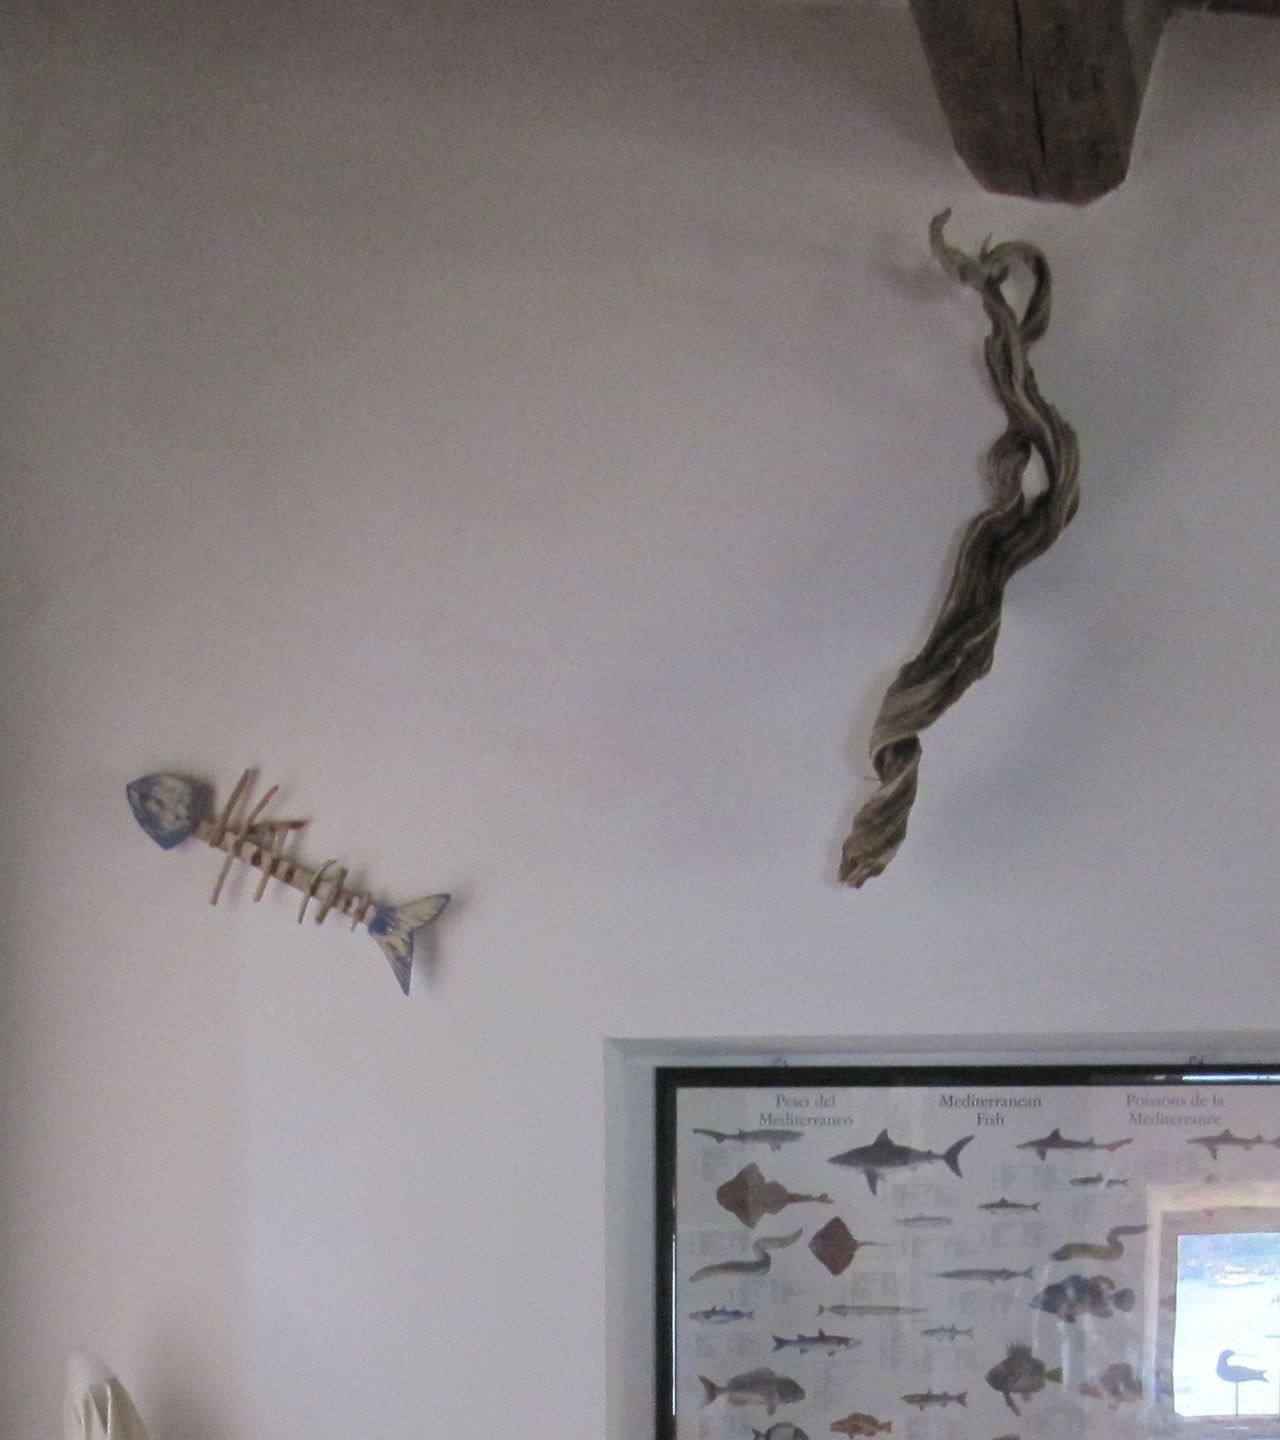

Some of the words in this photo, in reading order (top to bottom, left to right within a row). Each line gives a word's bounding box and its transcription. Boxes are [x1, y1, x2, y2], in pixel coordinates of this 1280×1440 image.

[814, 1093, 836, 1108] del
[939, 1093, 1043, 1108] Mediterranean
[1190, 1092, 1206, 1107] de
[758, 1111, 855, 1126] Mediterraneo
[976, 1112, 1005, 1126] Fish
